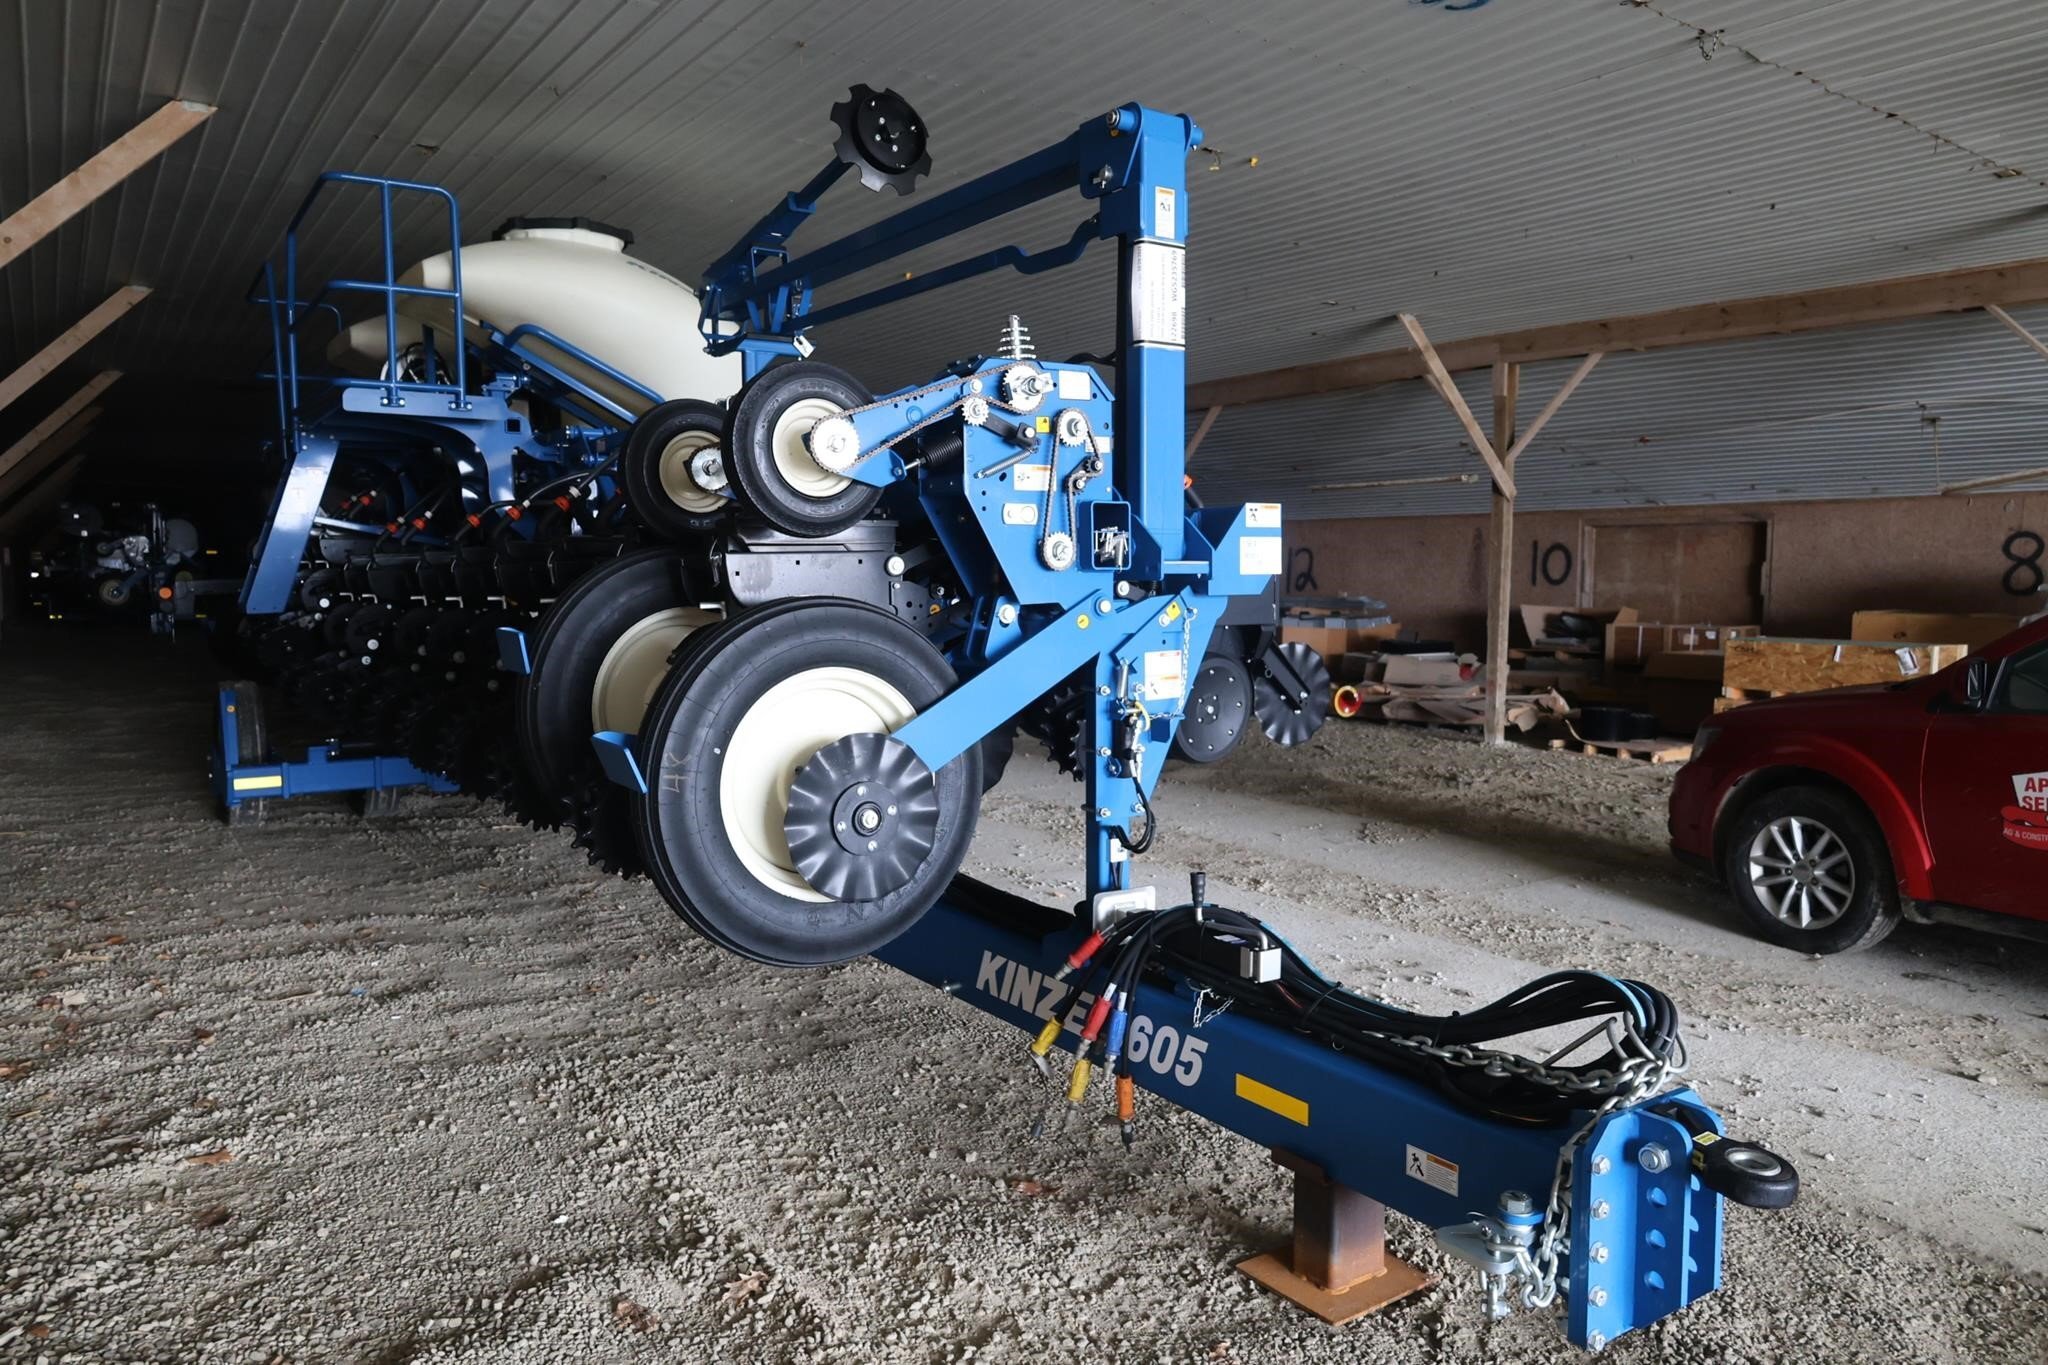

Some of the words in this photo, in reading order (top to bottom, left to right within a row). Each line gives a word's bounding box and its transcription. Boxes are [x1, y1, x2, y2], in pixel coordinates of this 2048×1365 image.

[1284, 547, 1318, 593] 12
[1530, 540, 1573, 586] 10
[2001, 531, 2046, 596] 8
[2021, 795, 2048, 812] SE
